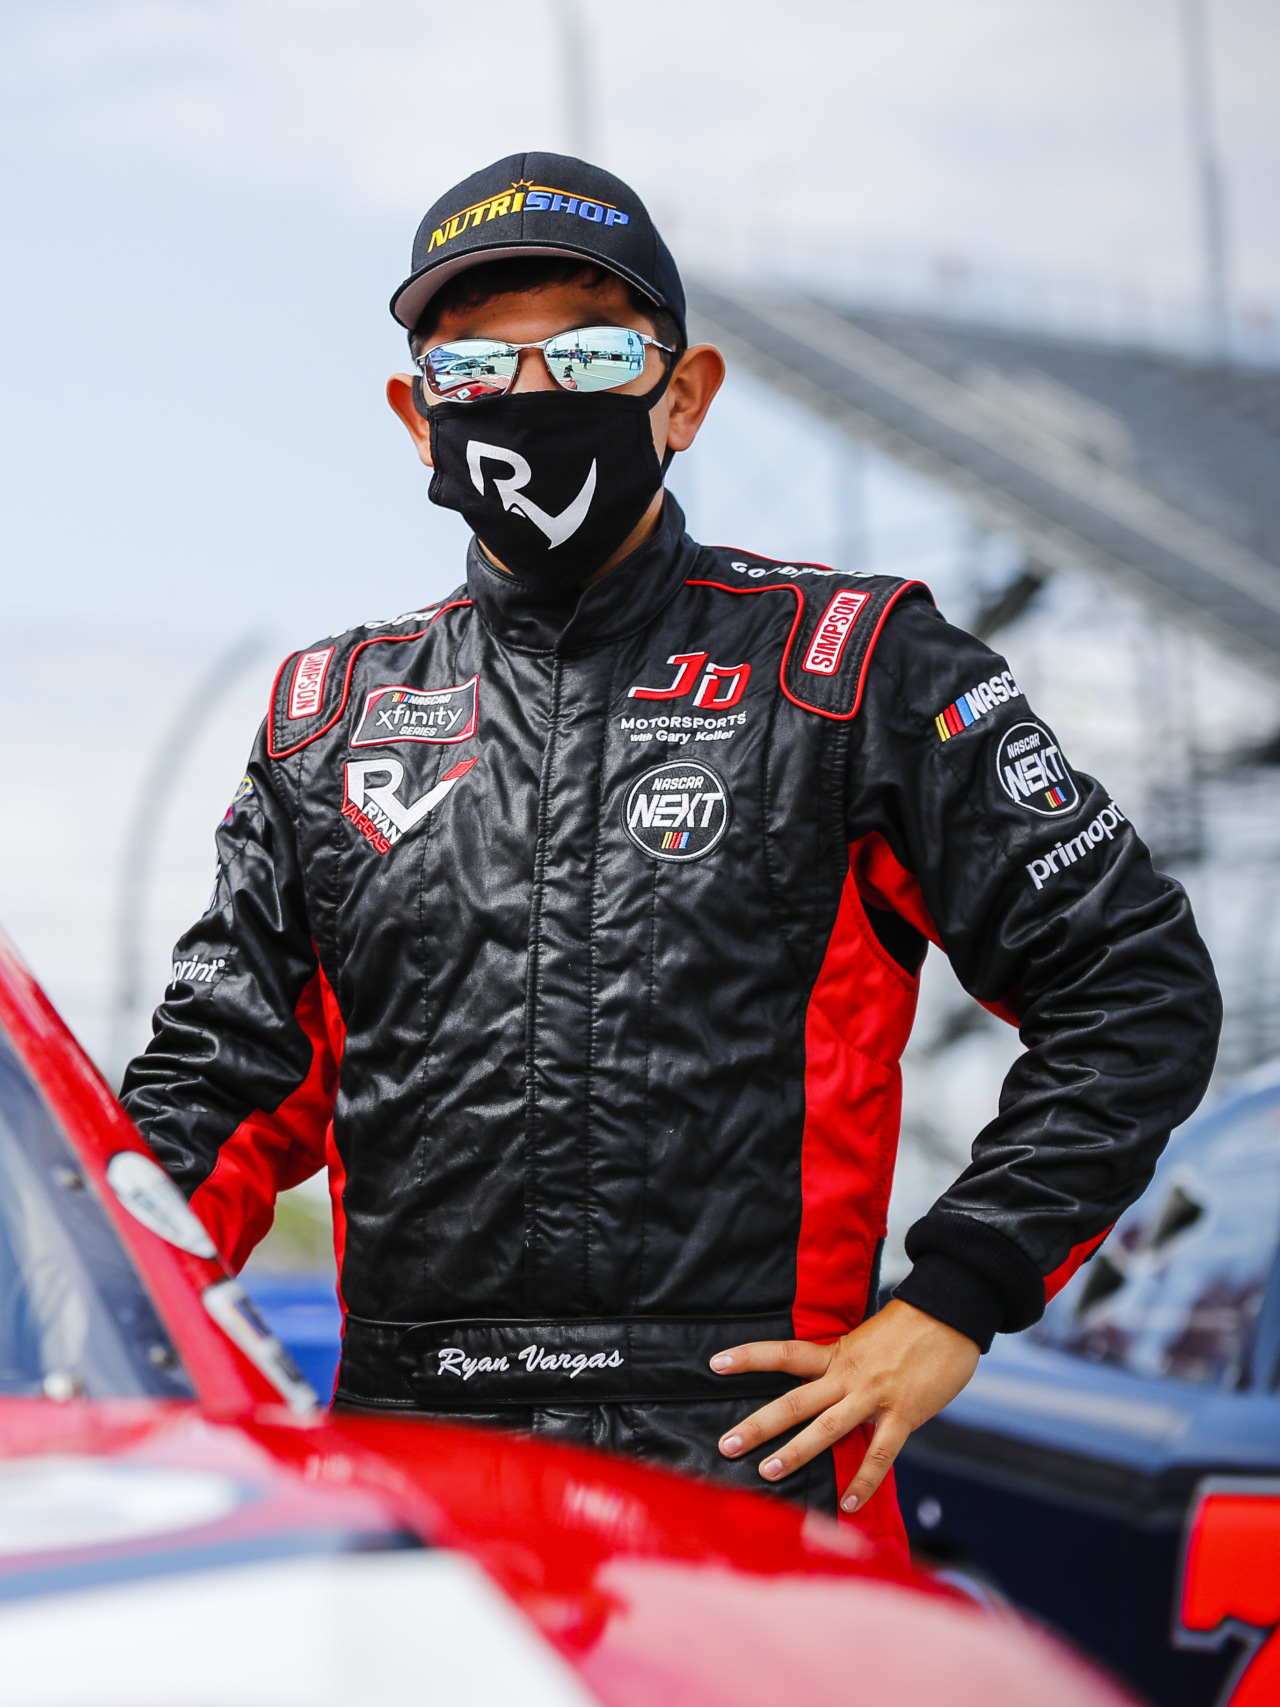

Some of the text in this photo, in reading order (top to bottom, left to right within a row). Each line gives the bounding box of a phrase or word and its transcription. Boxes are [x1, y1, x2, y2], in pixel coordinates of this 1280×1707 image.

[427, 192, 630, 253] NUTRISHOP
[811, 596, 861, 669] SIMPSON
[295, 653, 328, 712] SIMPSON
[409, 694, 453, 706] NASCAR
[964, 671, 1023, 721] NASC
[375, 703, 464, 732] xfinity
[399, 725, 438, 737] SERIES
[620, 712, 748, 730] MOTORSPORTS
[630, 729, 736, 745] with Gary Keller
[1006, 732, 1041, 759] NASCAR
[651, 775, 705, 791] NASCAR
[1003, 745, 1065, 803] NEXT
[341, 797, 393, 855] VARGAS
[361, 800, 403, 846] RYAN
[628, 792, 725, 829] NEXT
[1025, 795, 1126, 890] primopr
[169, 954, 222, 990] print
[437, 1344, 624, 1381] Ryan Vargas
